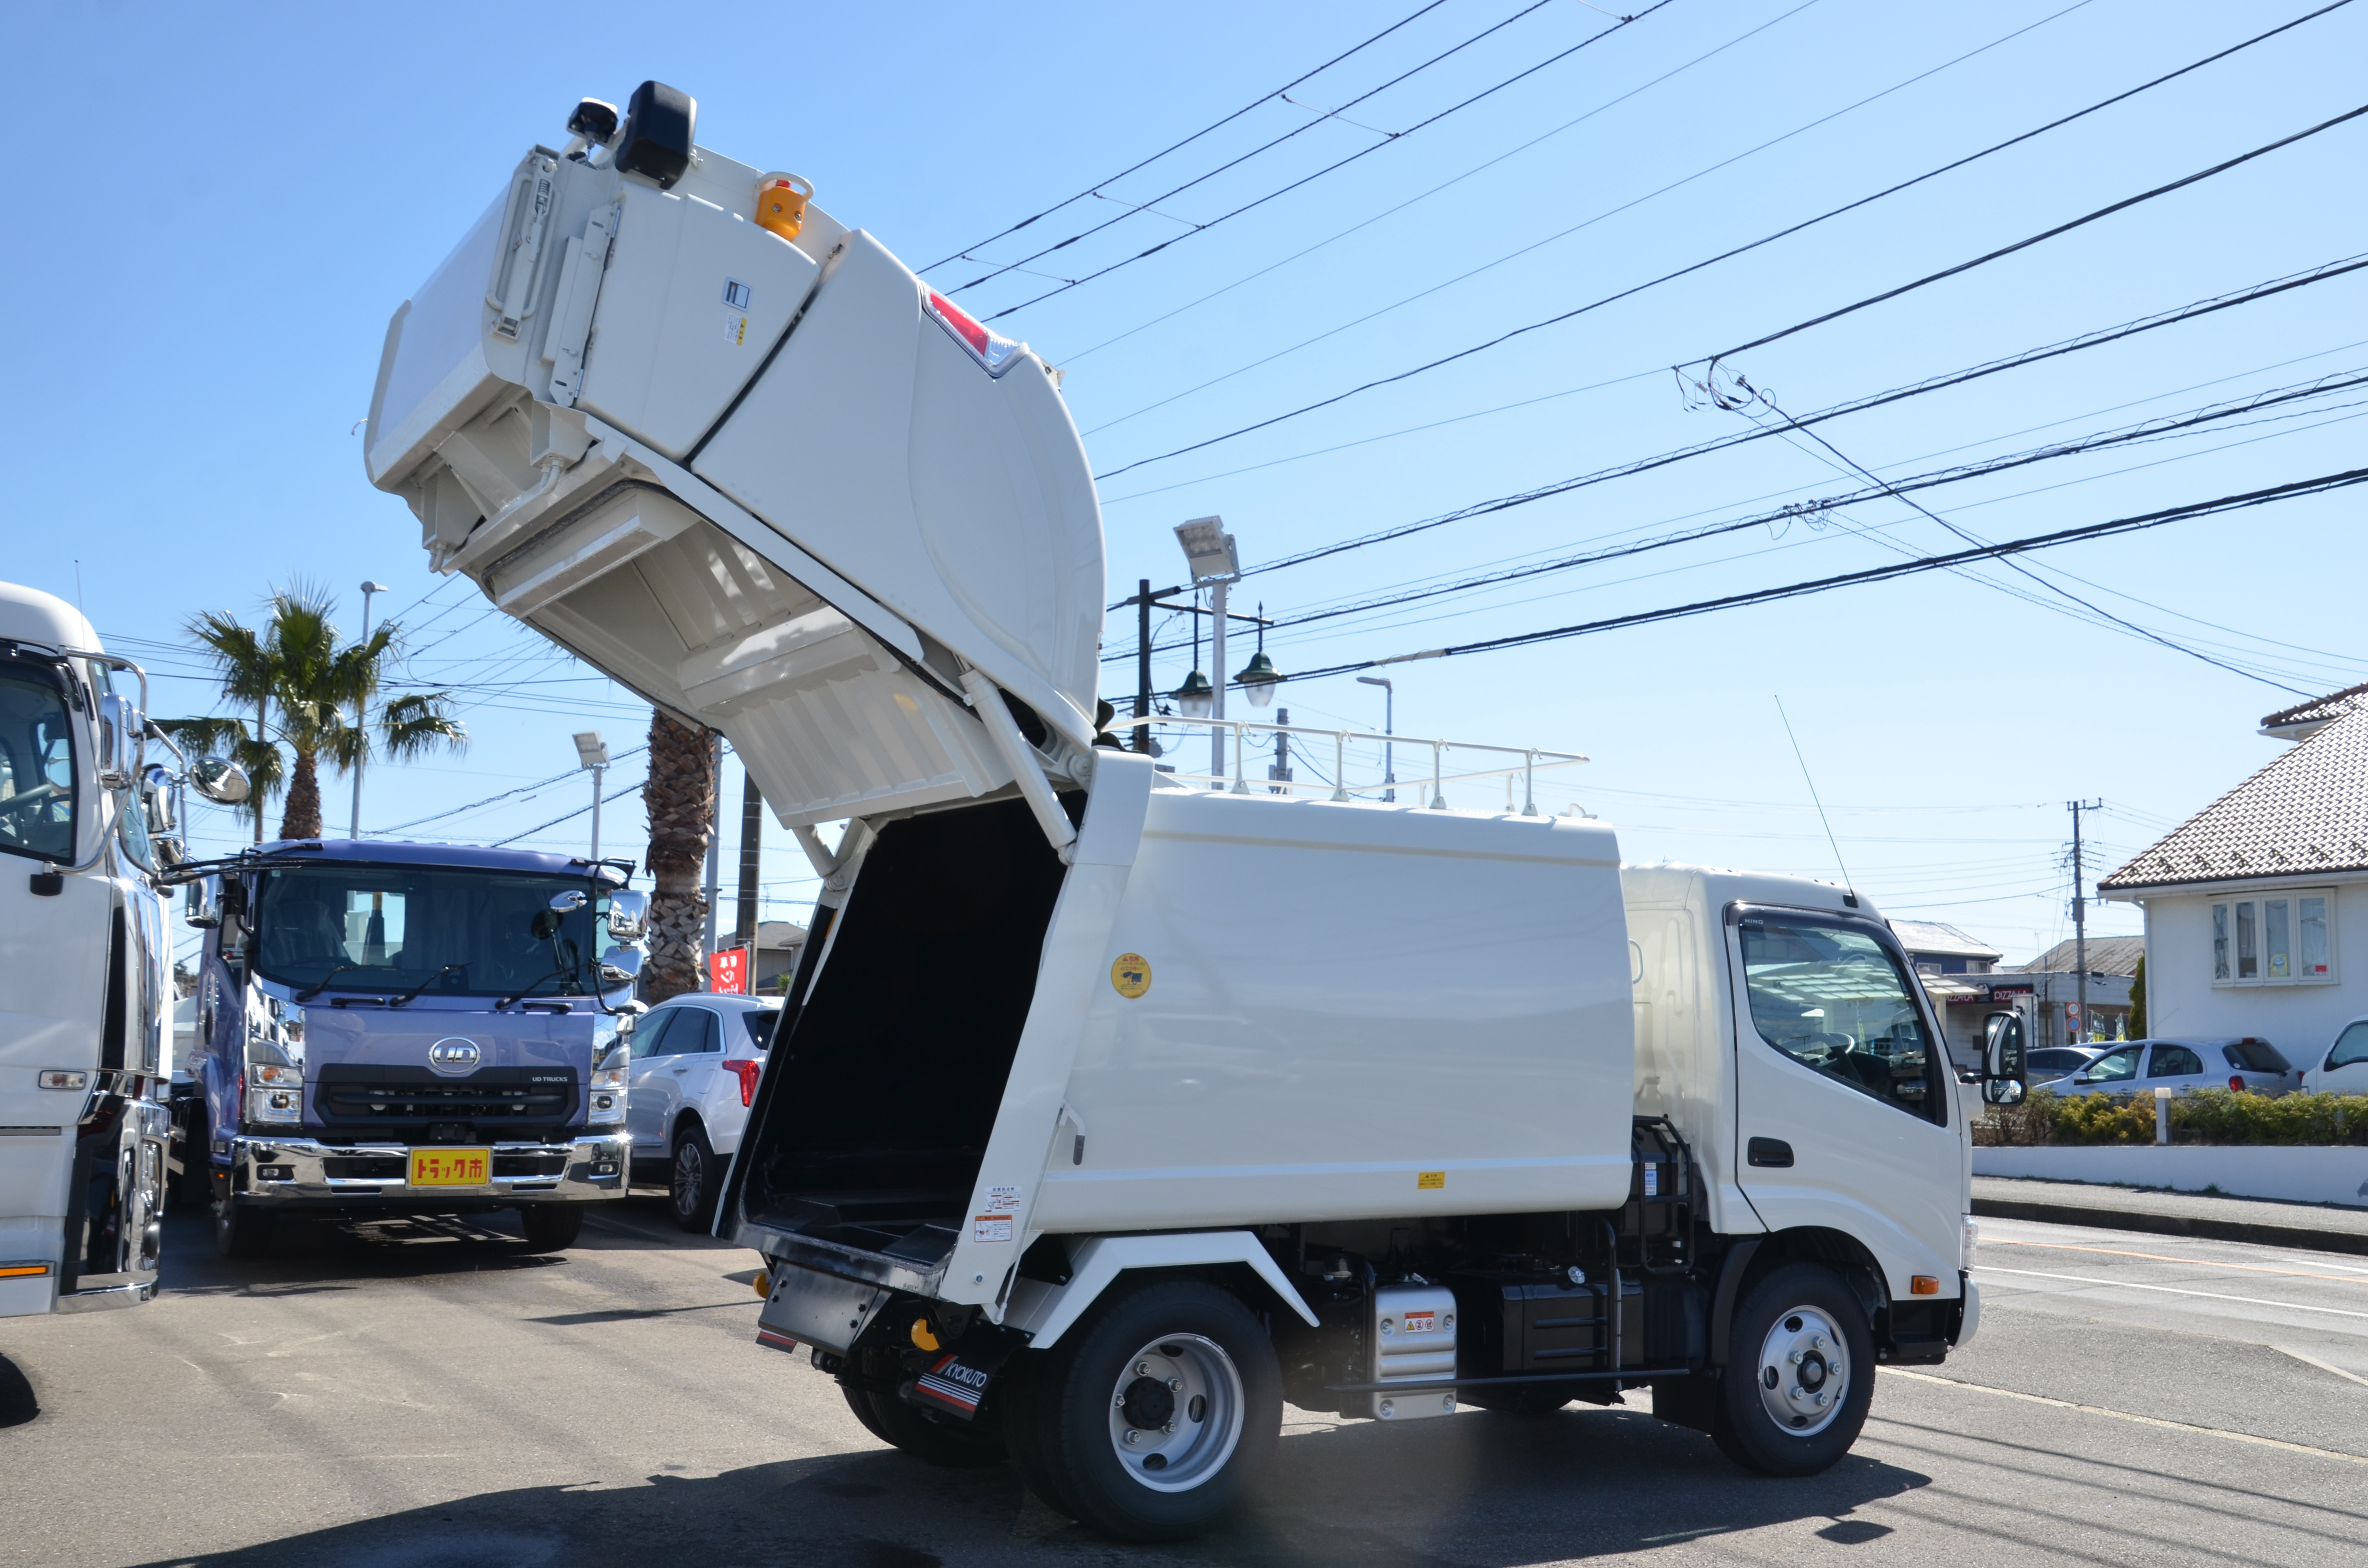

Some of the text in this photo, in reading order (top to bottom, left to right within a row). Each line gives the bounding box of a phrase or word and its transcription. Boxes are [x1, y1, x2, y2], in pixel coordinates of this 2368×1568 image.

[433, 1047, 477, 1064] UD
[417, 1158, 482, 1179] トラック市
[945, 1362, 987, 1388] KYOKUTO
